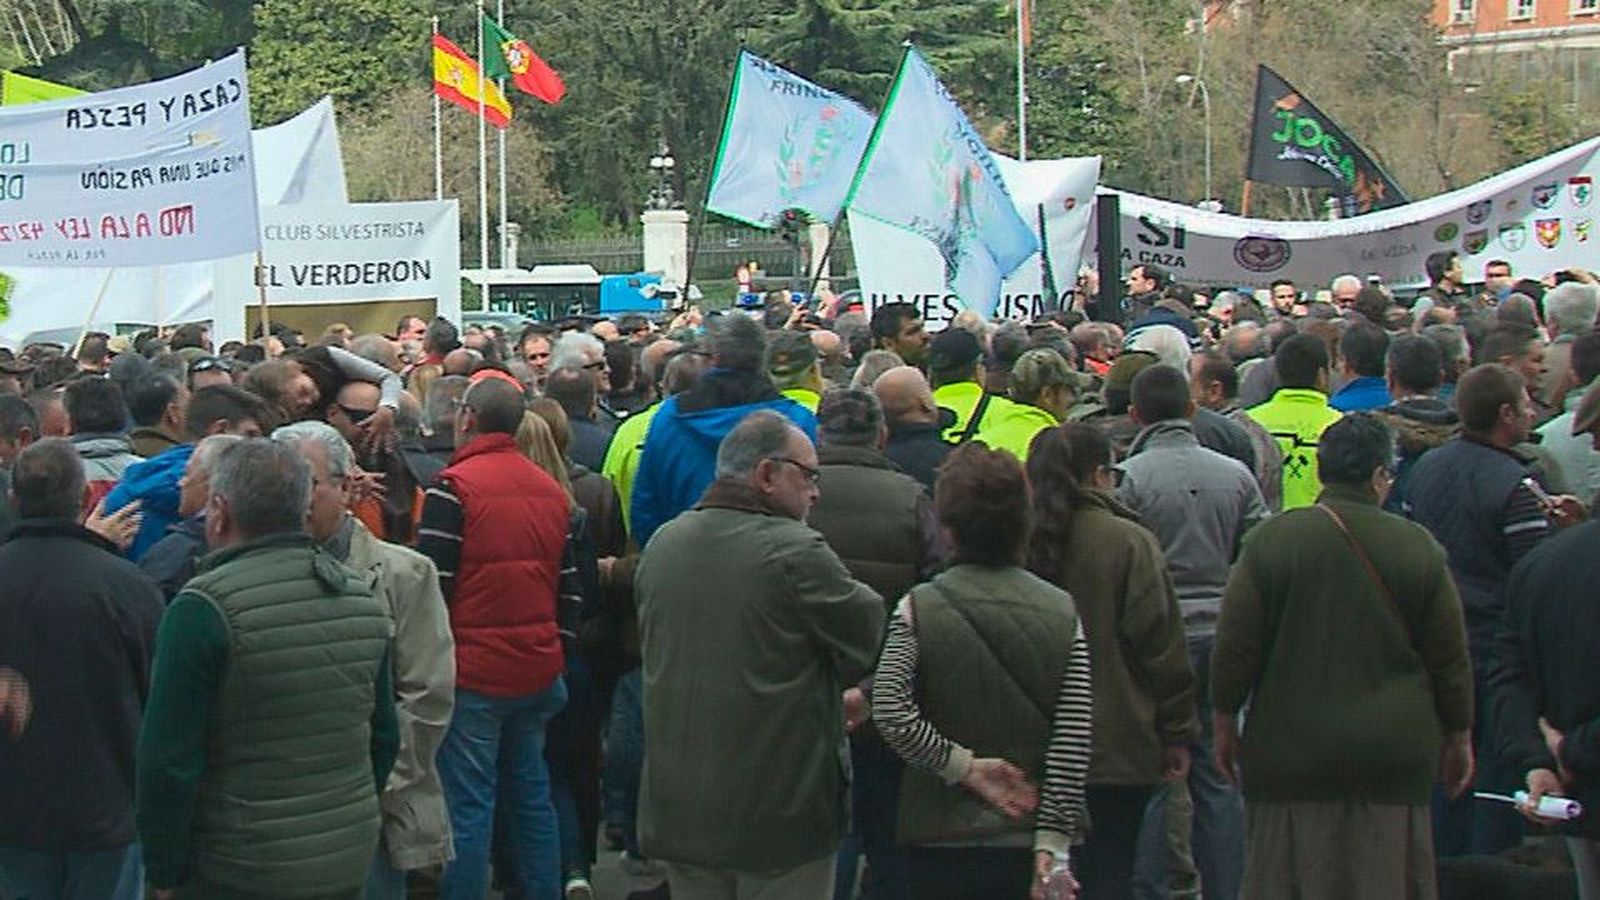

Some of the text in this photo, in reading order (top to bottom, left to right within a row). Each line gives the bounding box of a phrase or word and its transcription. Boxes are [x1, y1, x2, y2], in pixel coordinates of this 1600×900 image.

[264, 221, 425, 241] CLUB SILVESTRISTA
[1139, 250, 1187, 268] CAZA
[254, 259, 431, 288] EL VERDERON
